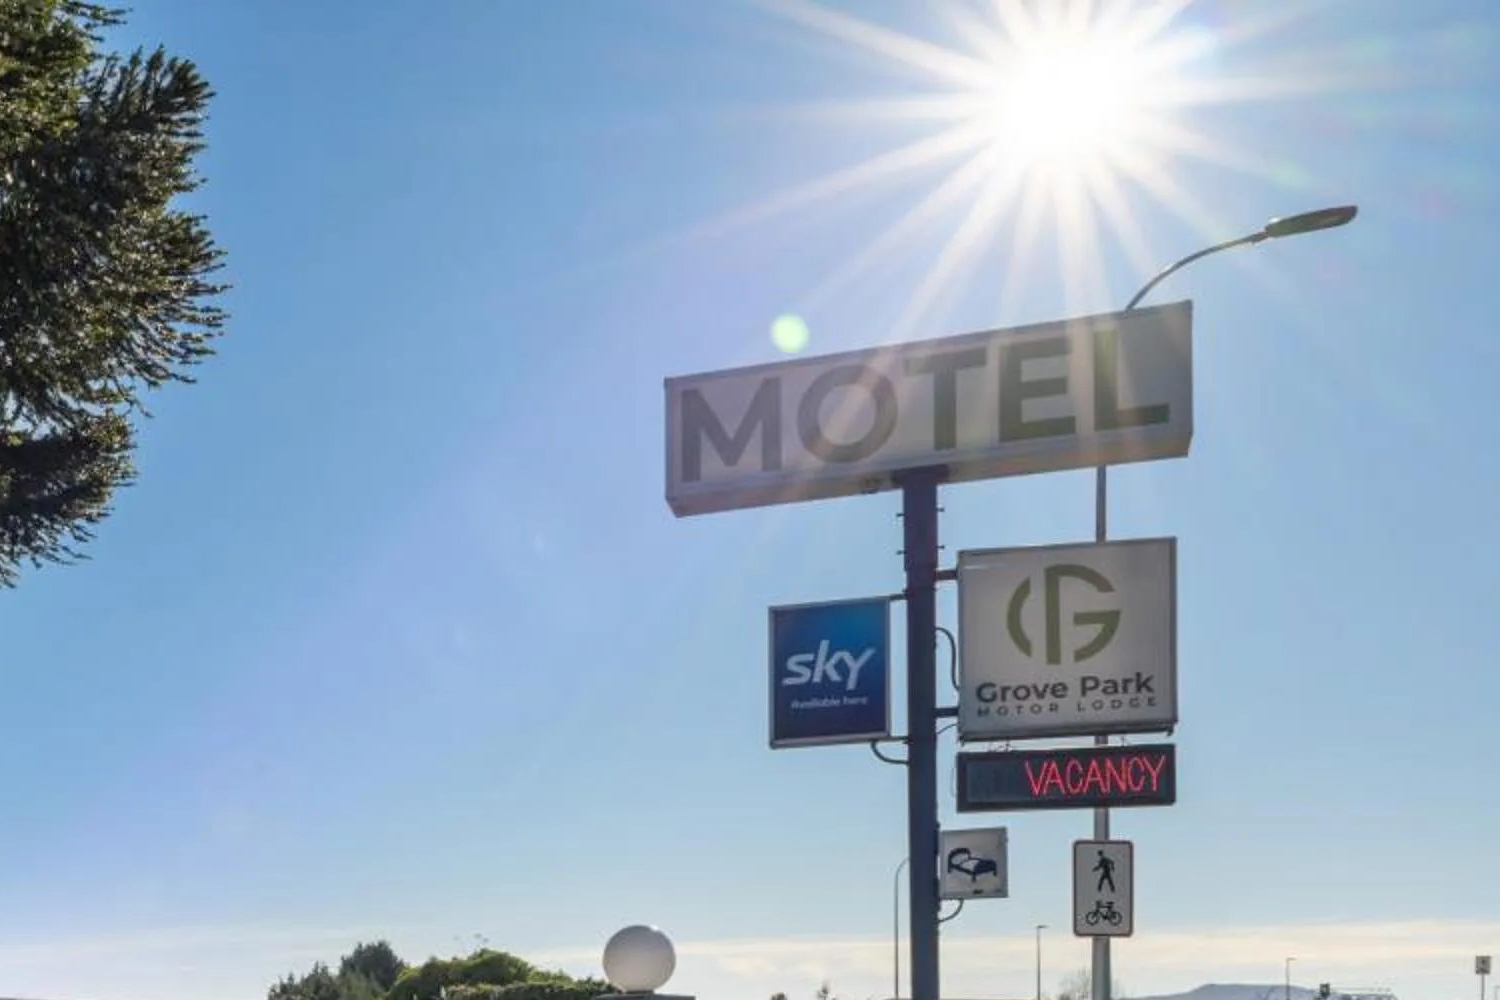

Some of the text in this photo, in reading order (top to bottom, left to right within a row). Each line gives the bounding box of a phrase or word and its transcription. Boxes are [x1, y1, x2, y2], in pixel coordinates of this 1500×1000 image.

[681, 329, 1170, 482] MOTEL
[781, 640, 875, 690] sky
[975, 672, 1155, 703] Grove Park
[977, 696, 1157, 717] MOTOR LODGE
[1023, 754, 1166, 797] VACANCY
